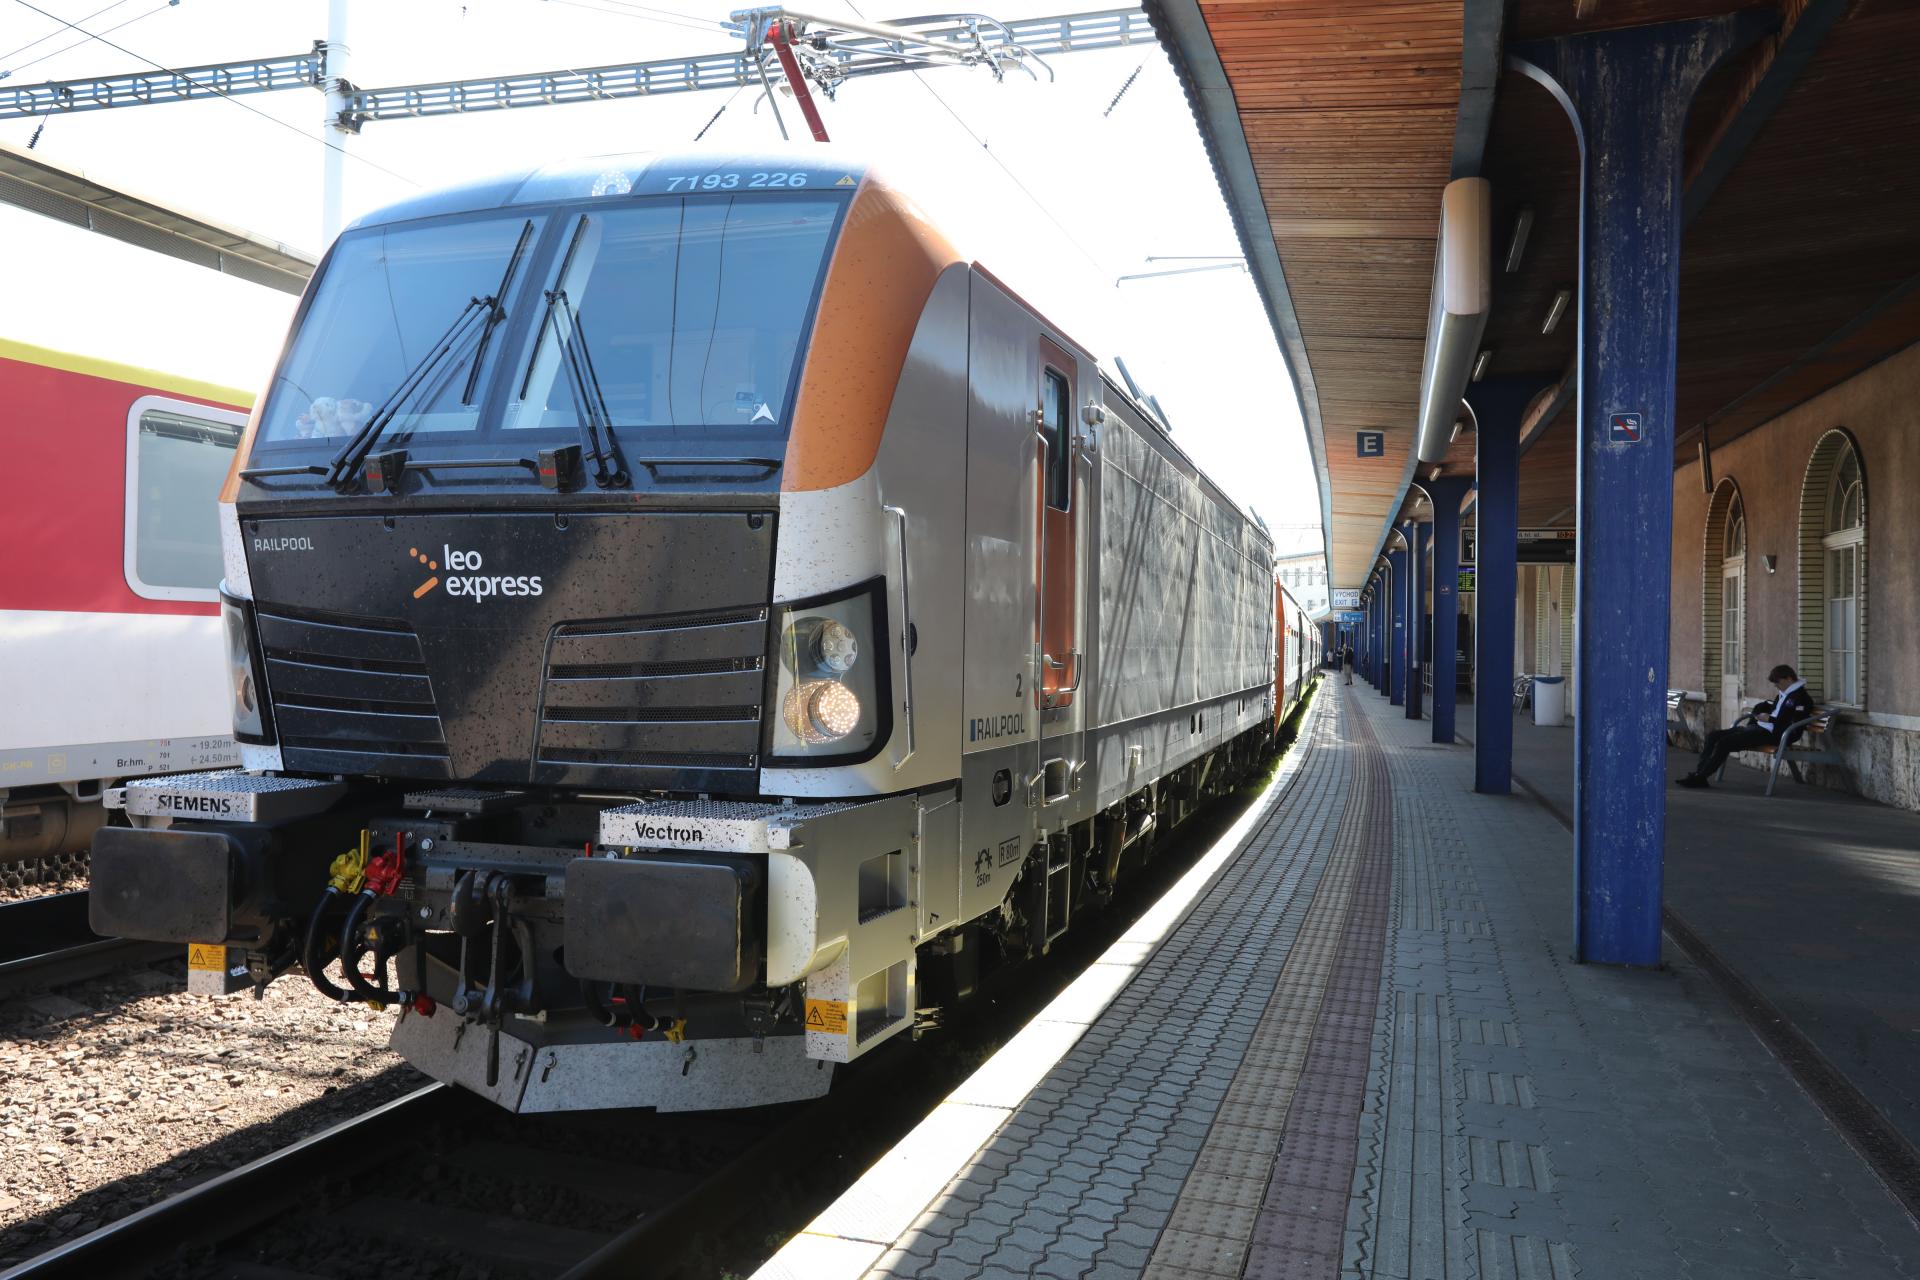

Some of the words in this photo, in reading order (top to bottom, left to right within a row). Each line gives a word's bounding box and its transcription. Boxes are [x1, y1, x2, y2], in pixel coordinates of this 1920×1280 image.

[666, 173, 740, 192] 7193
[748, 172, 808, 188] 226
[1363, 436, 1377, 452] E
[254, 537, 314, 551] RAILPOOL
[444, 544, 482, 571] leo
[446, 575, 543, 603] express
[1016, 673, 1022, 697] 2
[977, 712, 1025, 740] RAILPOOL
[158, 795, 231, 813] SIEMENS
[635, 821, 704, 842] Vectron
